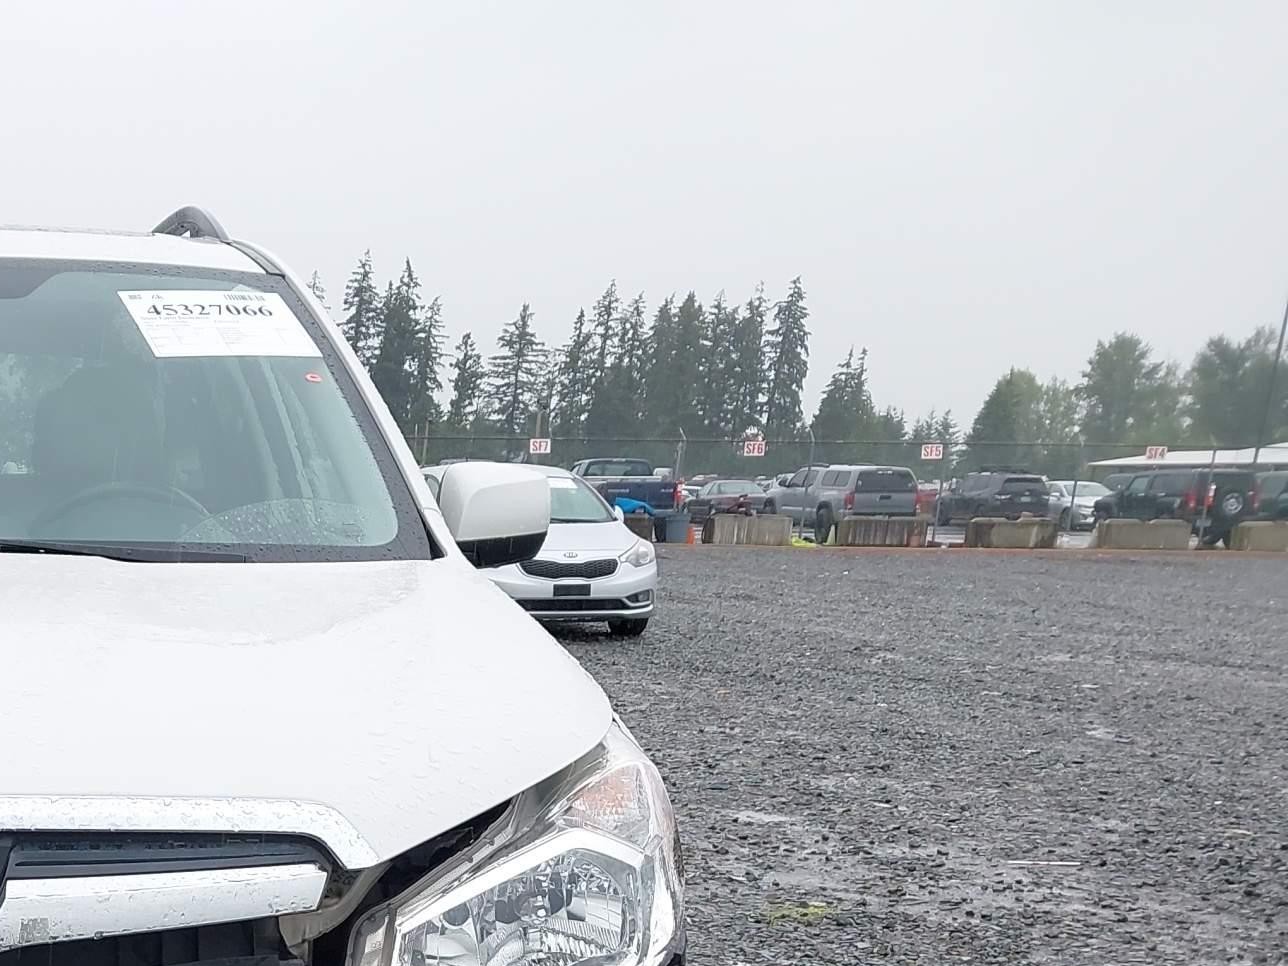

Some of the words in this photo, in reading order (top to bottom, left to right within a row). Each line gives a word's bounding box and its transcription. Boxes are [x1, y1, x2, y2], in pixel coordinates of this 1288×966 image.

[147, 304, 273, 316] 45327066
[532, 440, 548, 452] SF7
[746, 443, 764, 454] SF6
[923, 445, 941, 457] SF5
